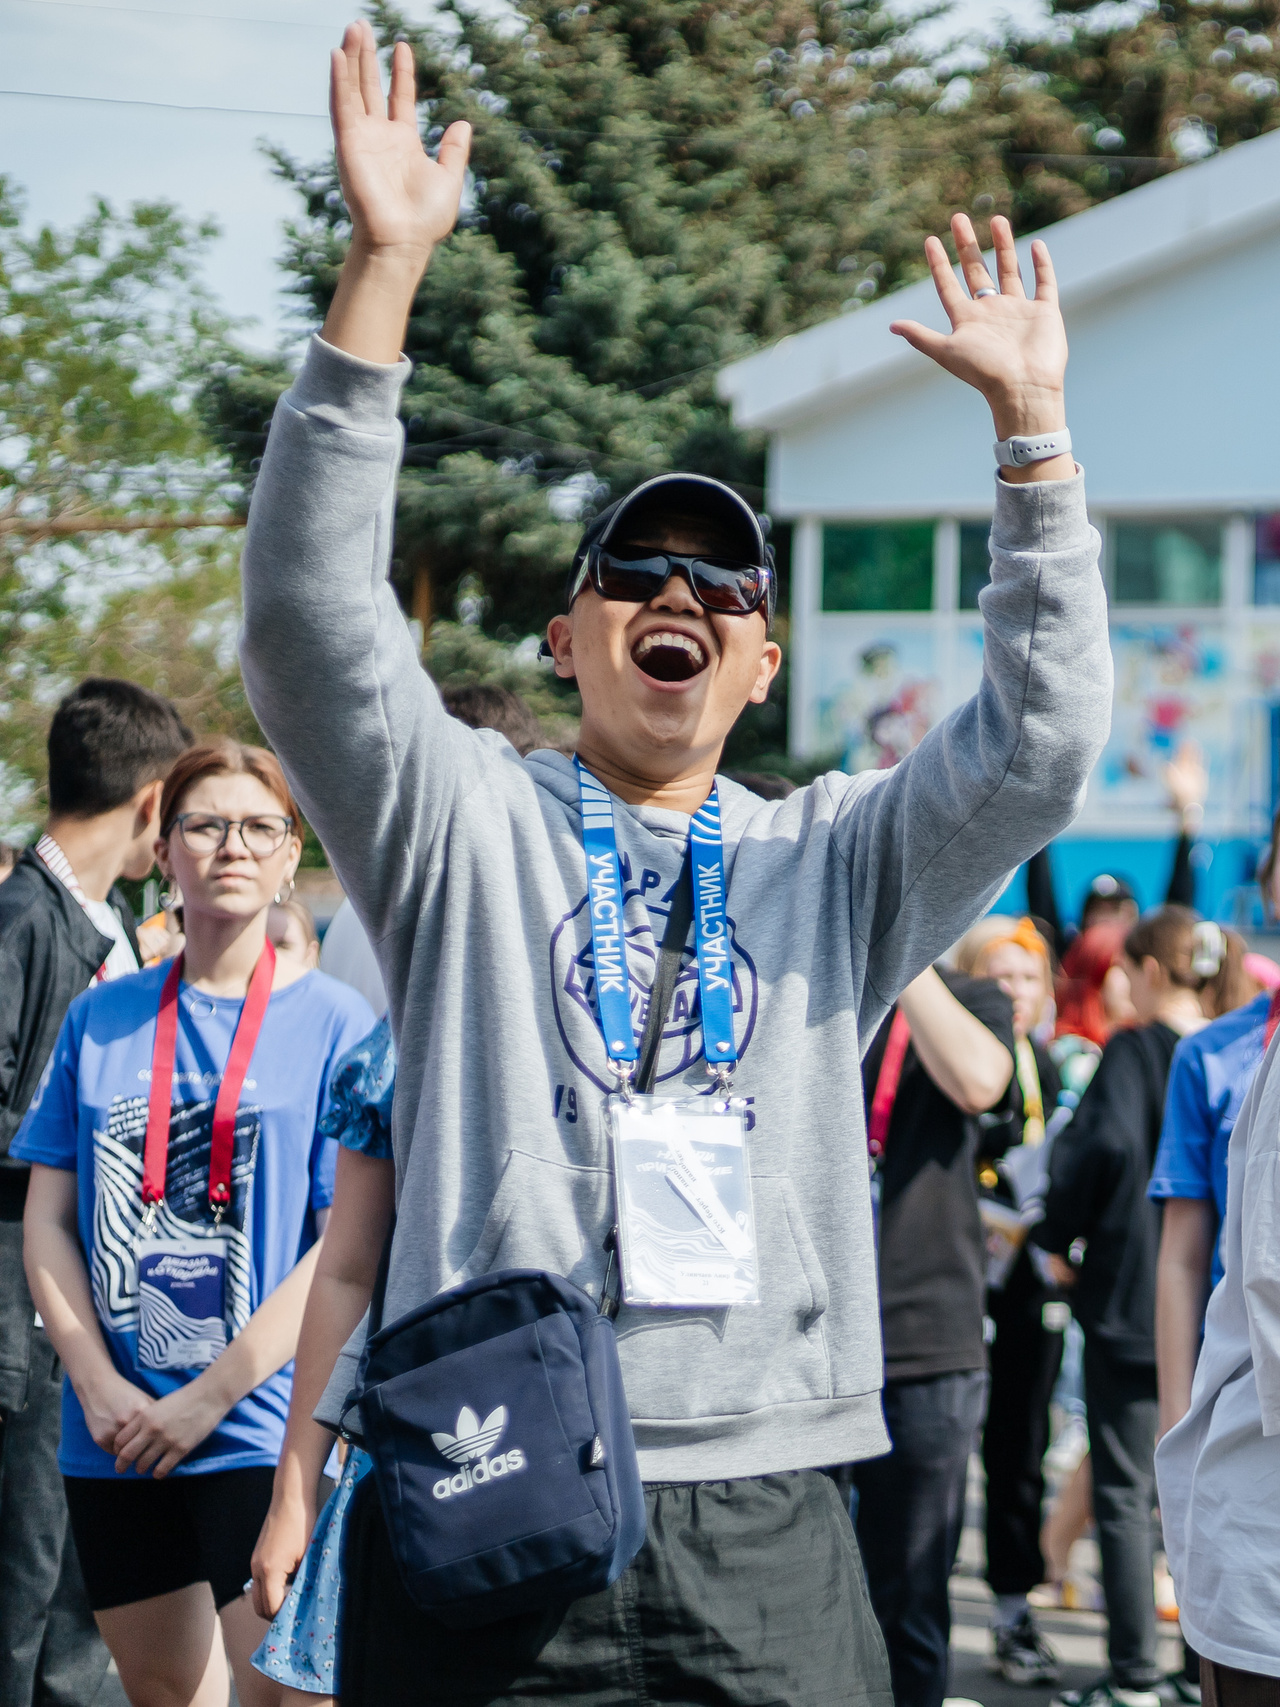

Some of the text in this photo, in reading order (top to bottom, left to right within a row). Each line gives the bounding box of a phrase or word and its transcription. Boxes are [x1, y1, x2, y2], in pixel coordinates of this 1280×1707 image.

[590, 852, 624, 992] УЧАСТНИК
[698, 862, 729, 991] УЧАСТНИК
[552, 1084, 578, 1124] 19
[432, 1449, 525, 1500] adidas
